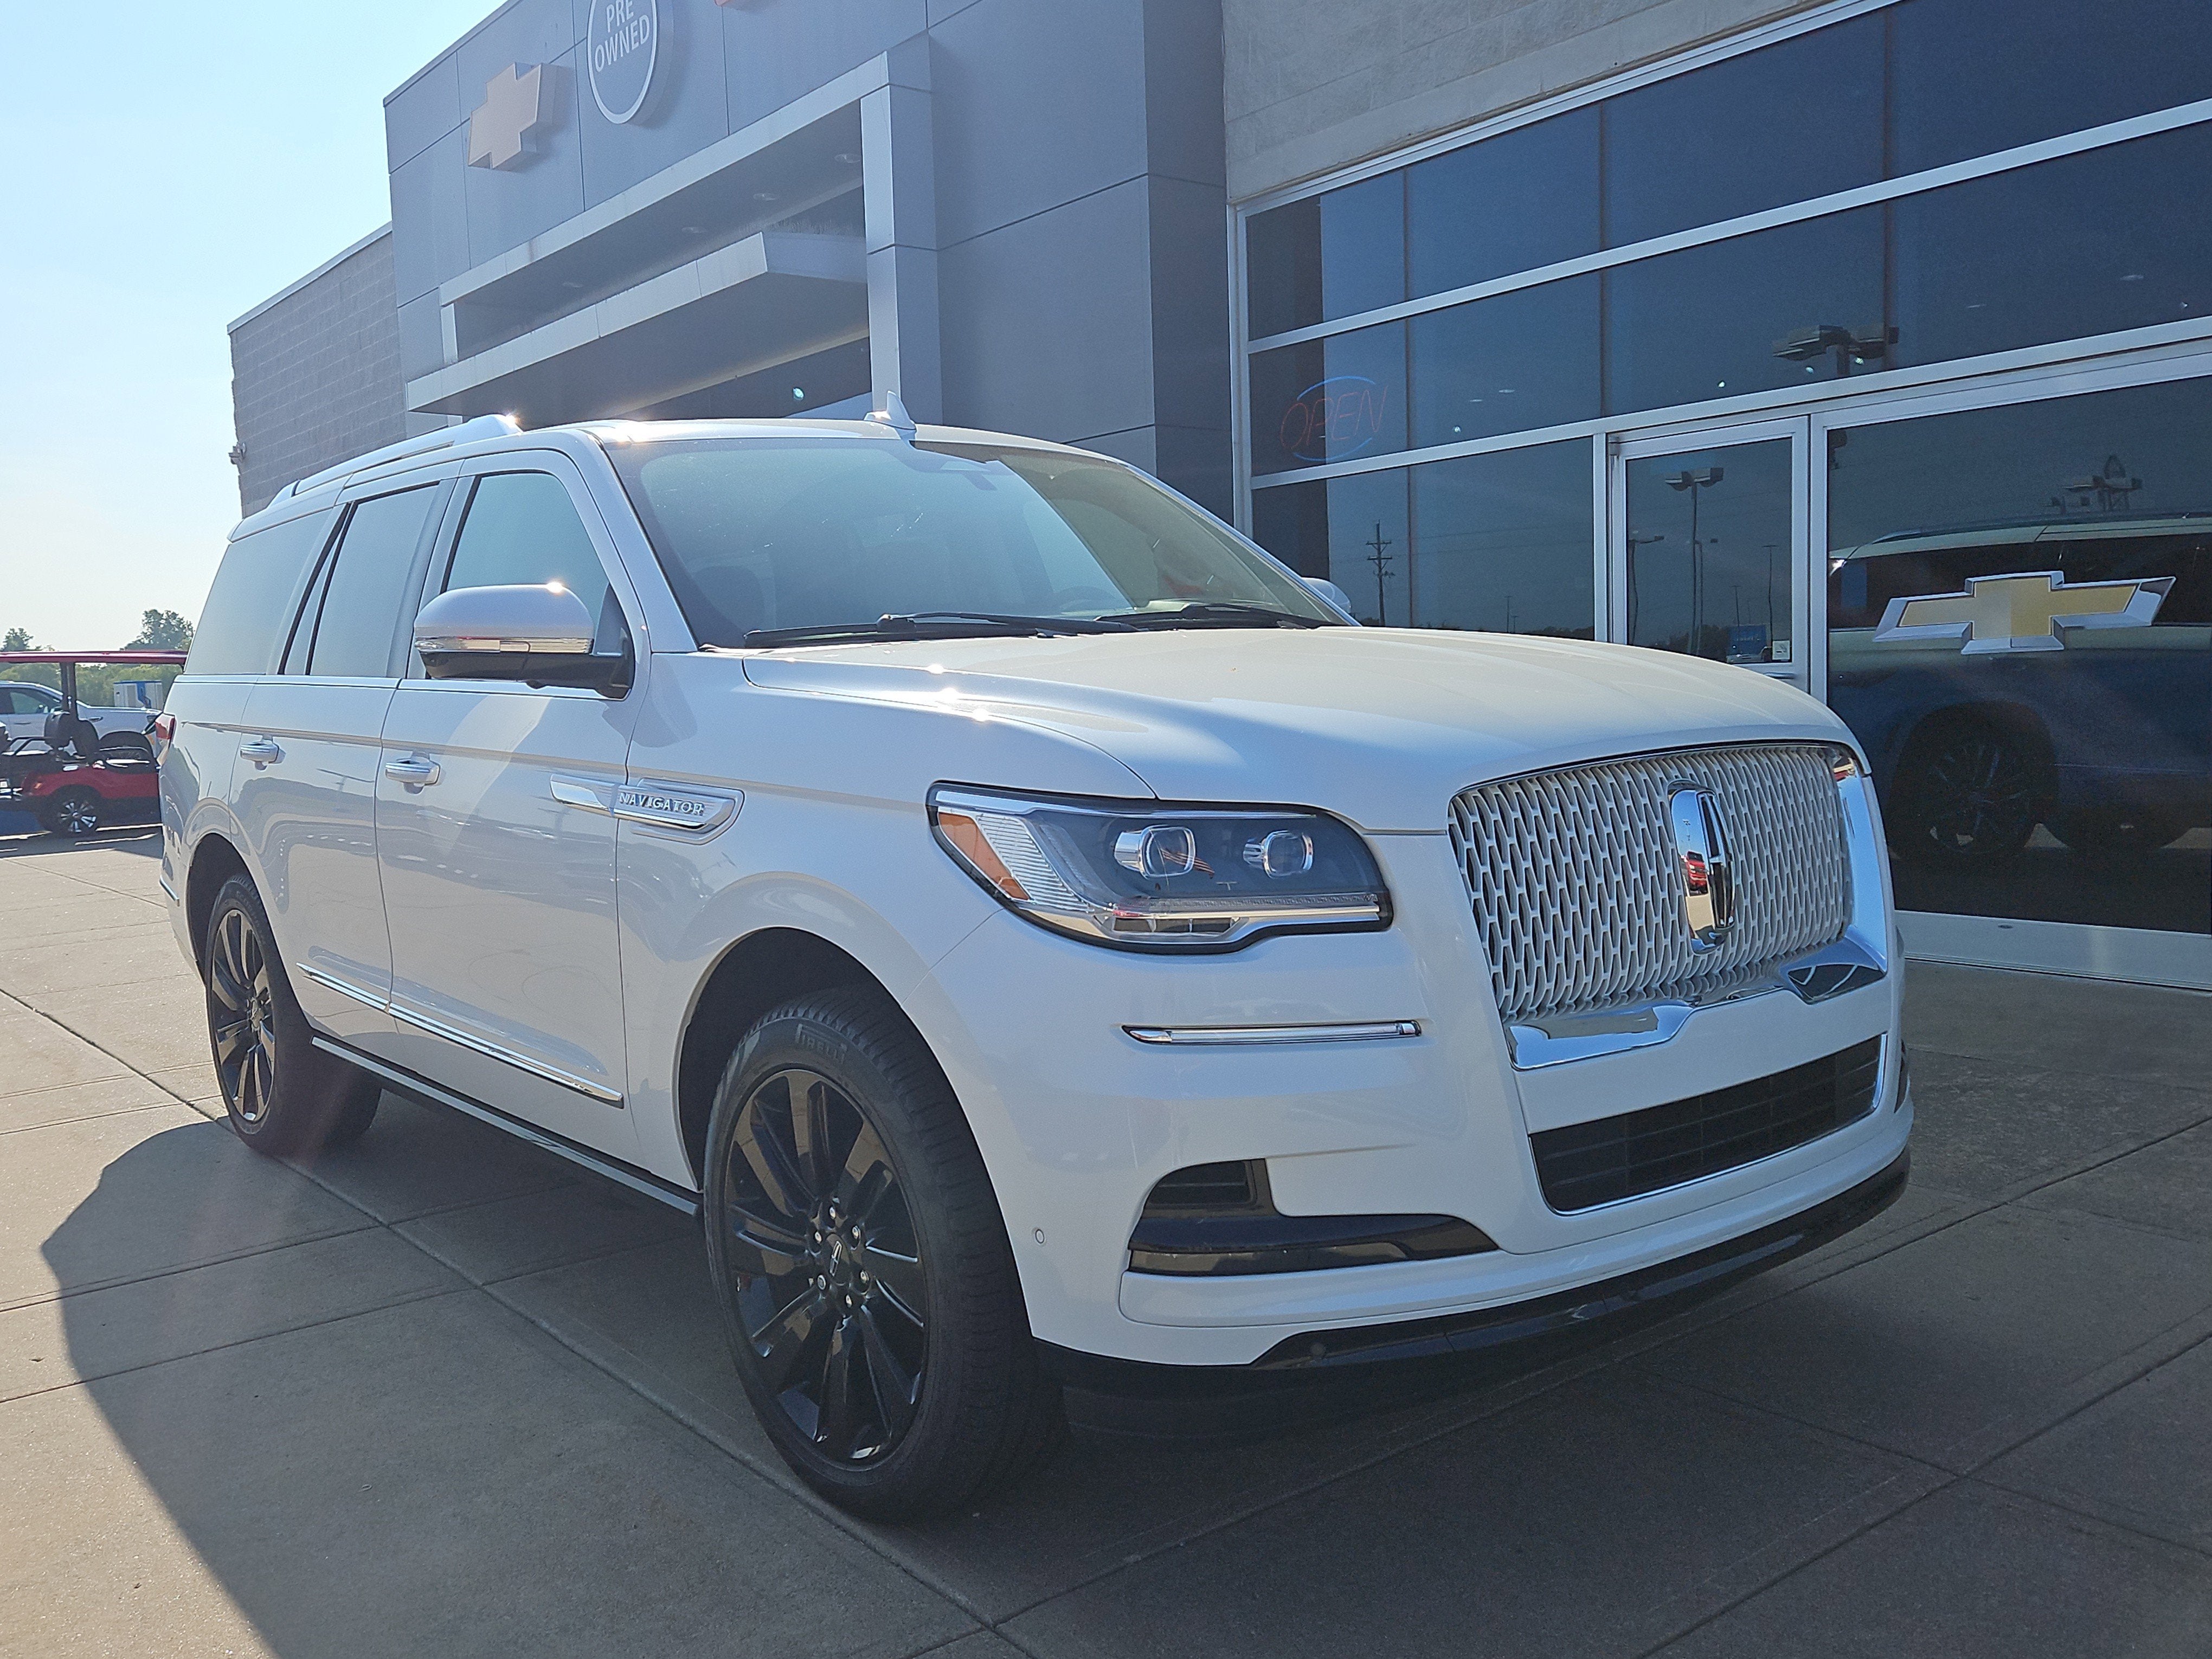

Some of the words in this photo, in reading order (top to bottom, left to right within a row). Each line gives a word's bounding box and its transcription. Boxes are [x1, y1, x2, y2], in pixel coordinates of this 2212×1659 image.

[606, 0, 634, 33] PRE
[595, 15, 650, 72] OWNED
[1280, 386, 1388, 450] OPEN
[619, 792, 704, 816] NAVIGATOR
[794, 1023, 848, 1065] PIRELLI
